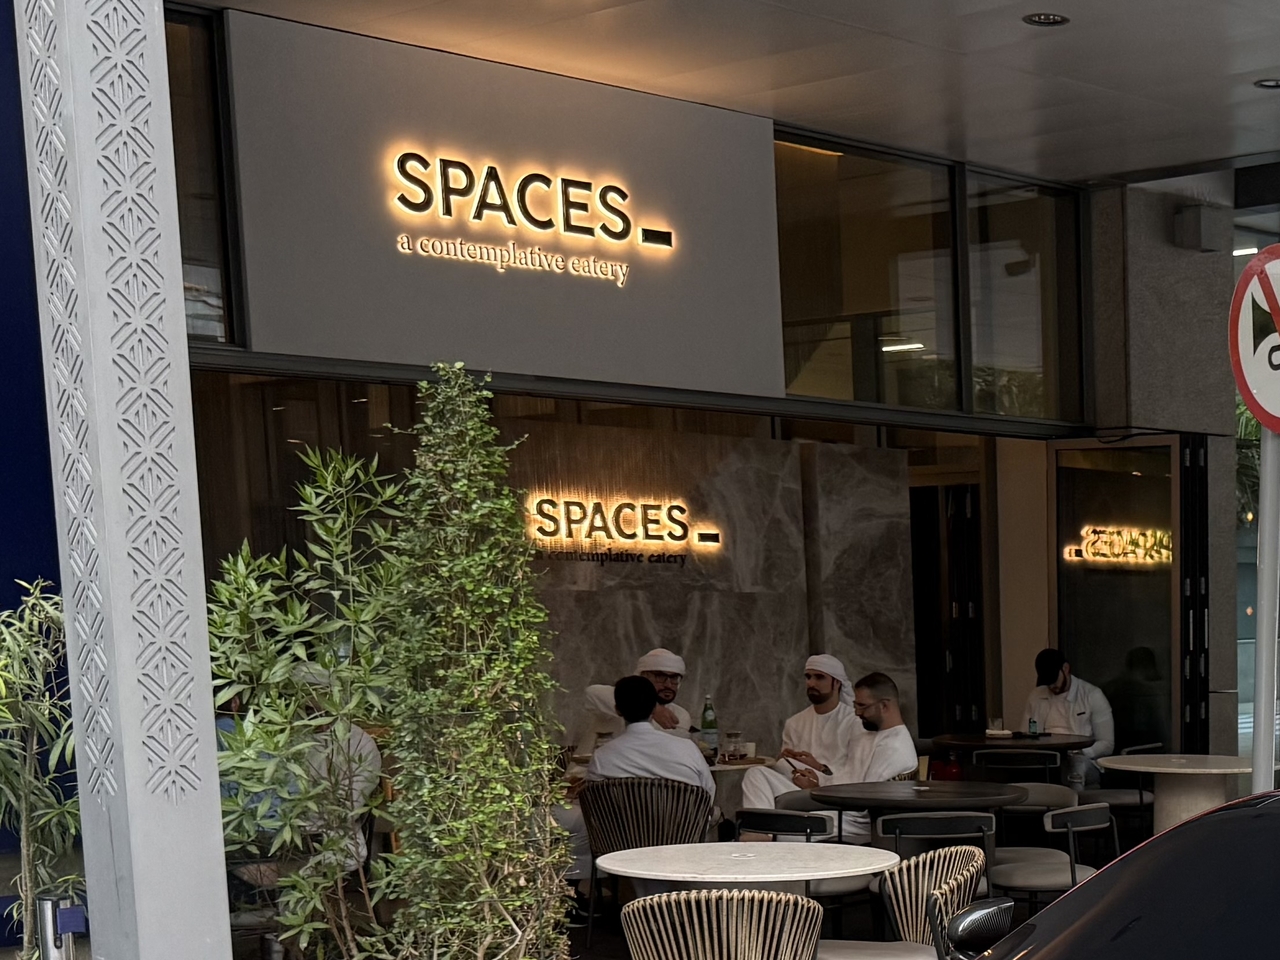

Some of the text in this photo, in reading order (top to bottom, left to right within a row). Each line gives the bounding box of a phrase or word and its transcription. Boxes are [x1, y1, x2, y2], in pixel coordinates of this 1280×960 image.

[398, 233, 631, 287] a contemplative eatery
[647, 549, 687, 568] eatery
